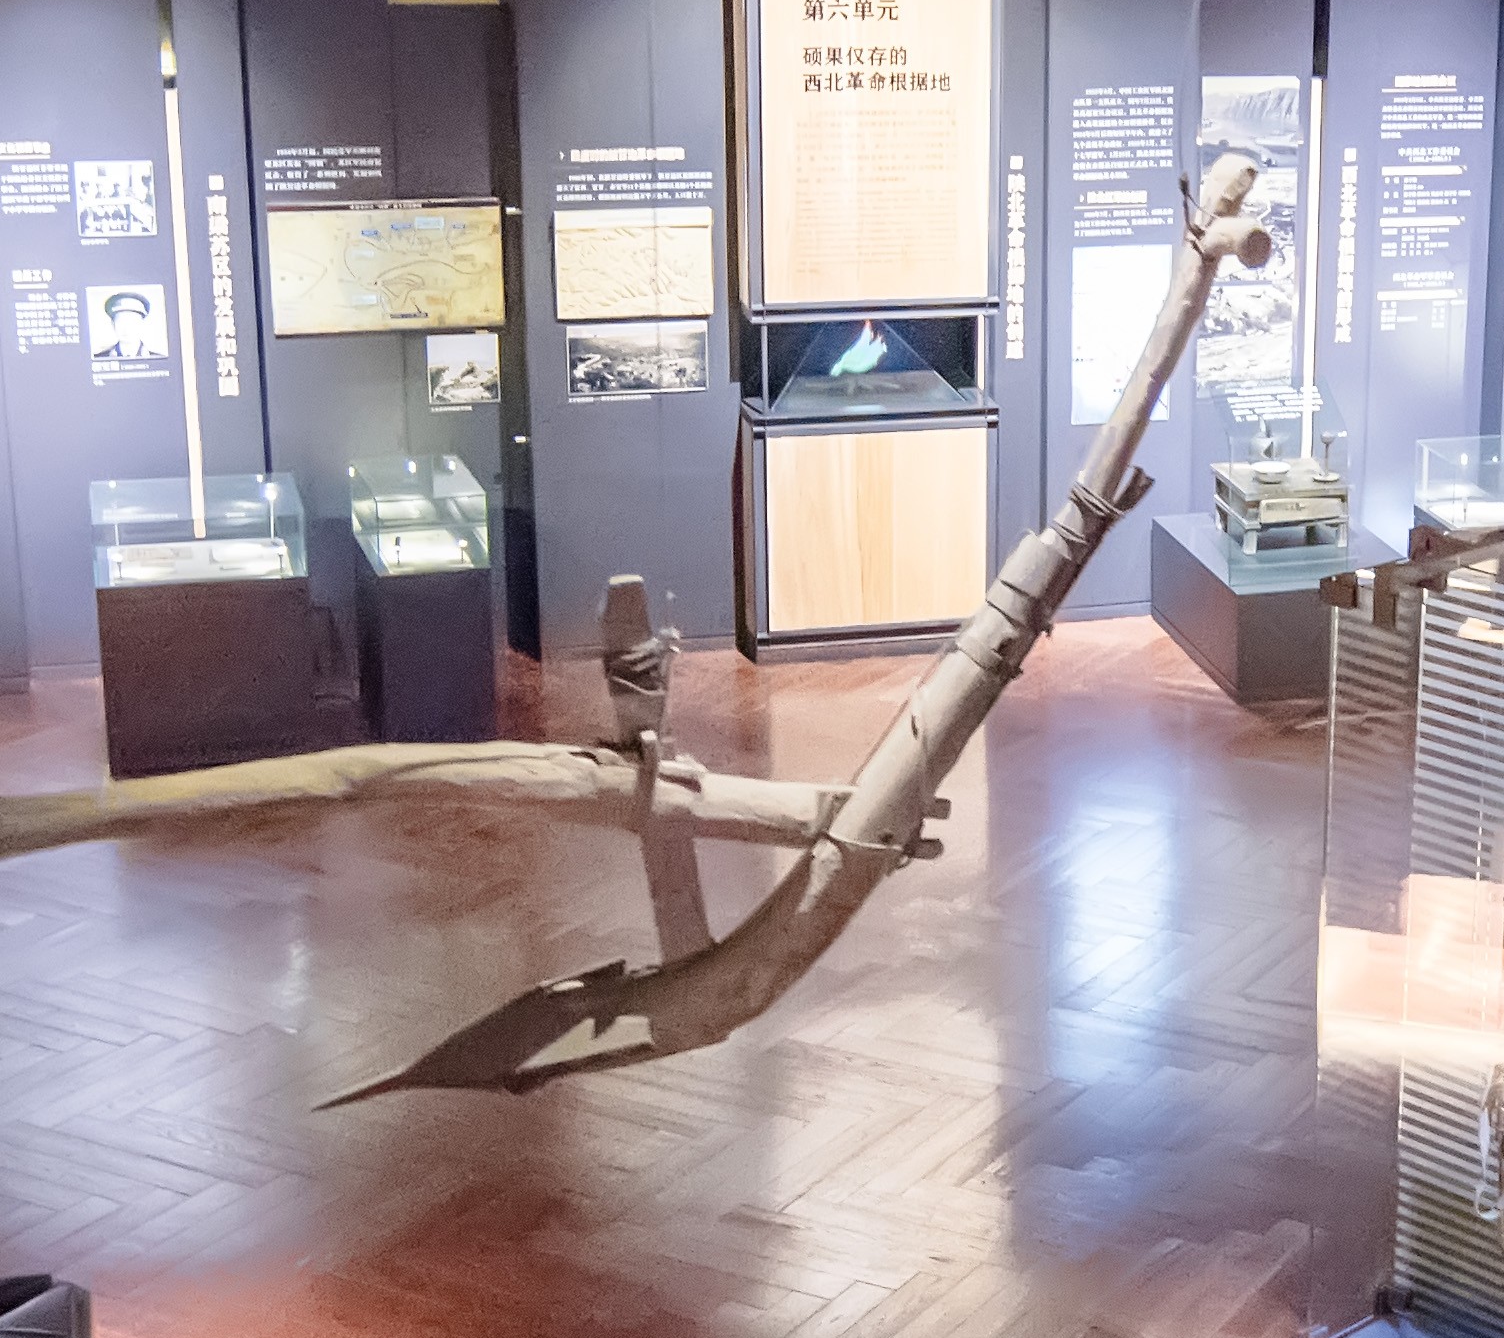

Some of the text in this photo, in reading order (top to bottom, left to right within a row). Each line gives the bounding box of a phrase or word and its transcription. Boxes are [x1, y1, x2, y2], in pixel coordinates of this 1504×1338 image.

[802, 45, 908, 67] 硕果仅存的
[802, 72, 951, 93] 西北革命根据地
